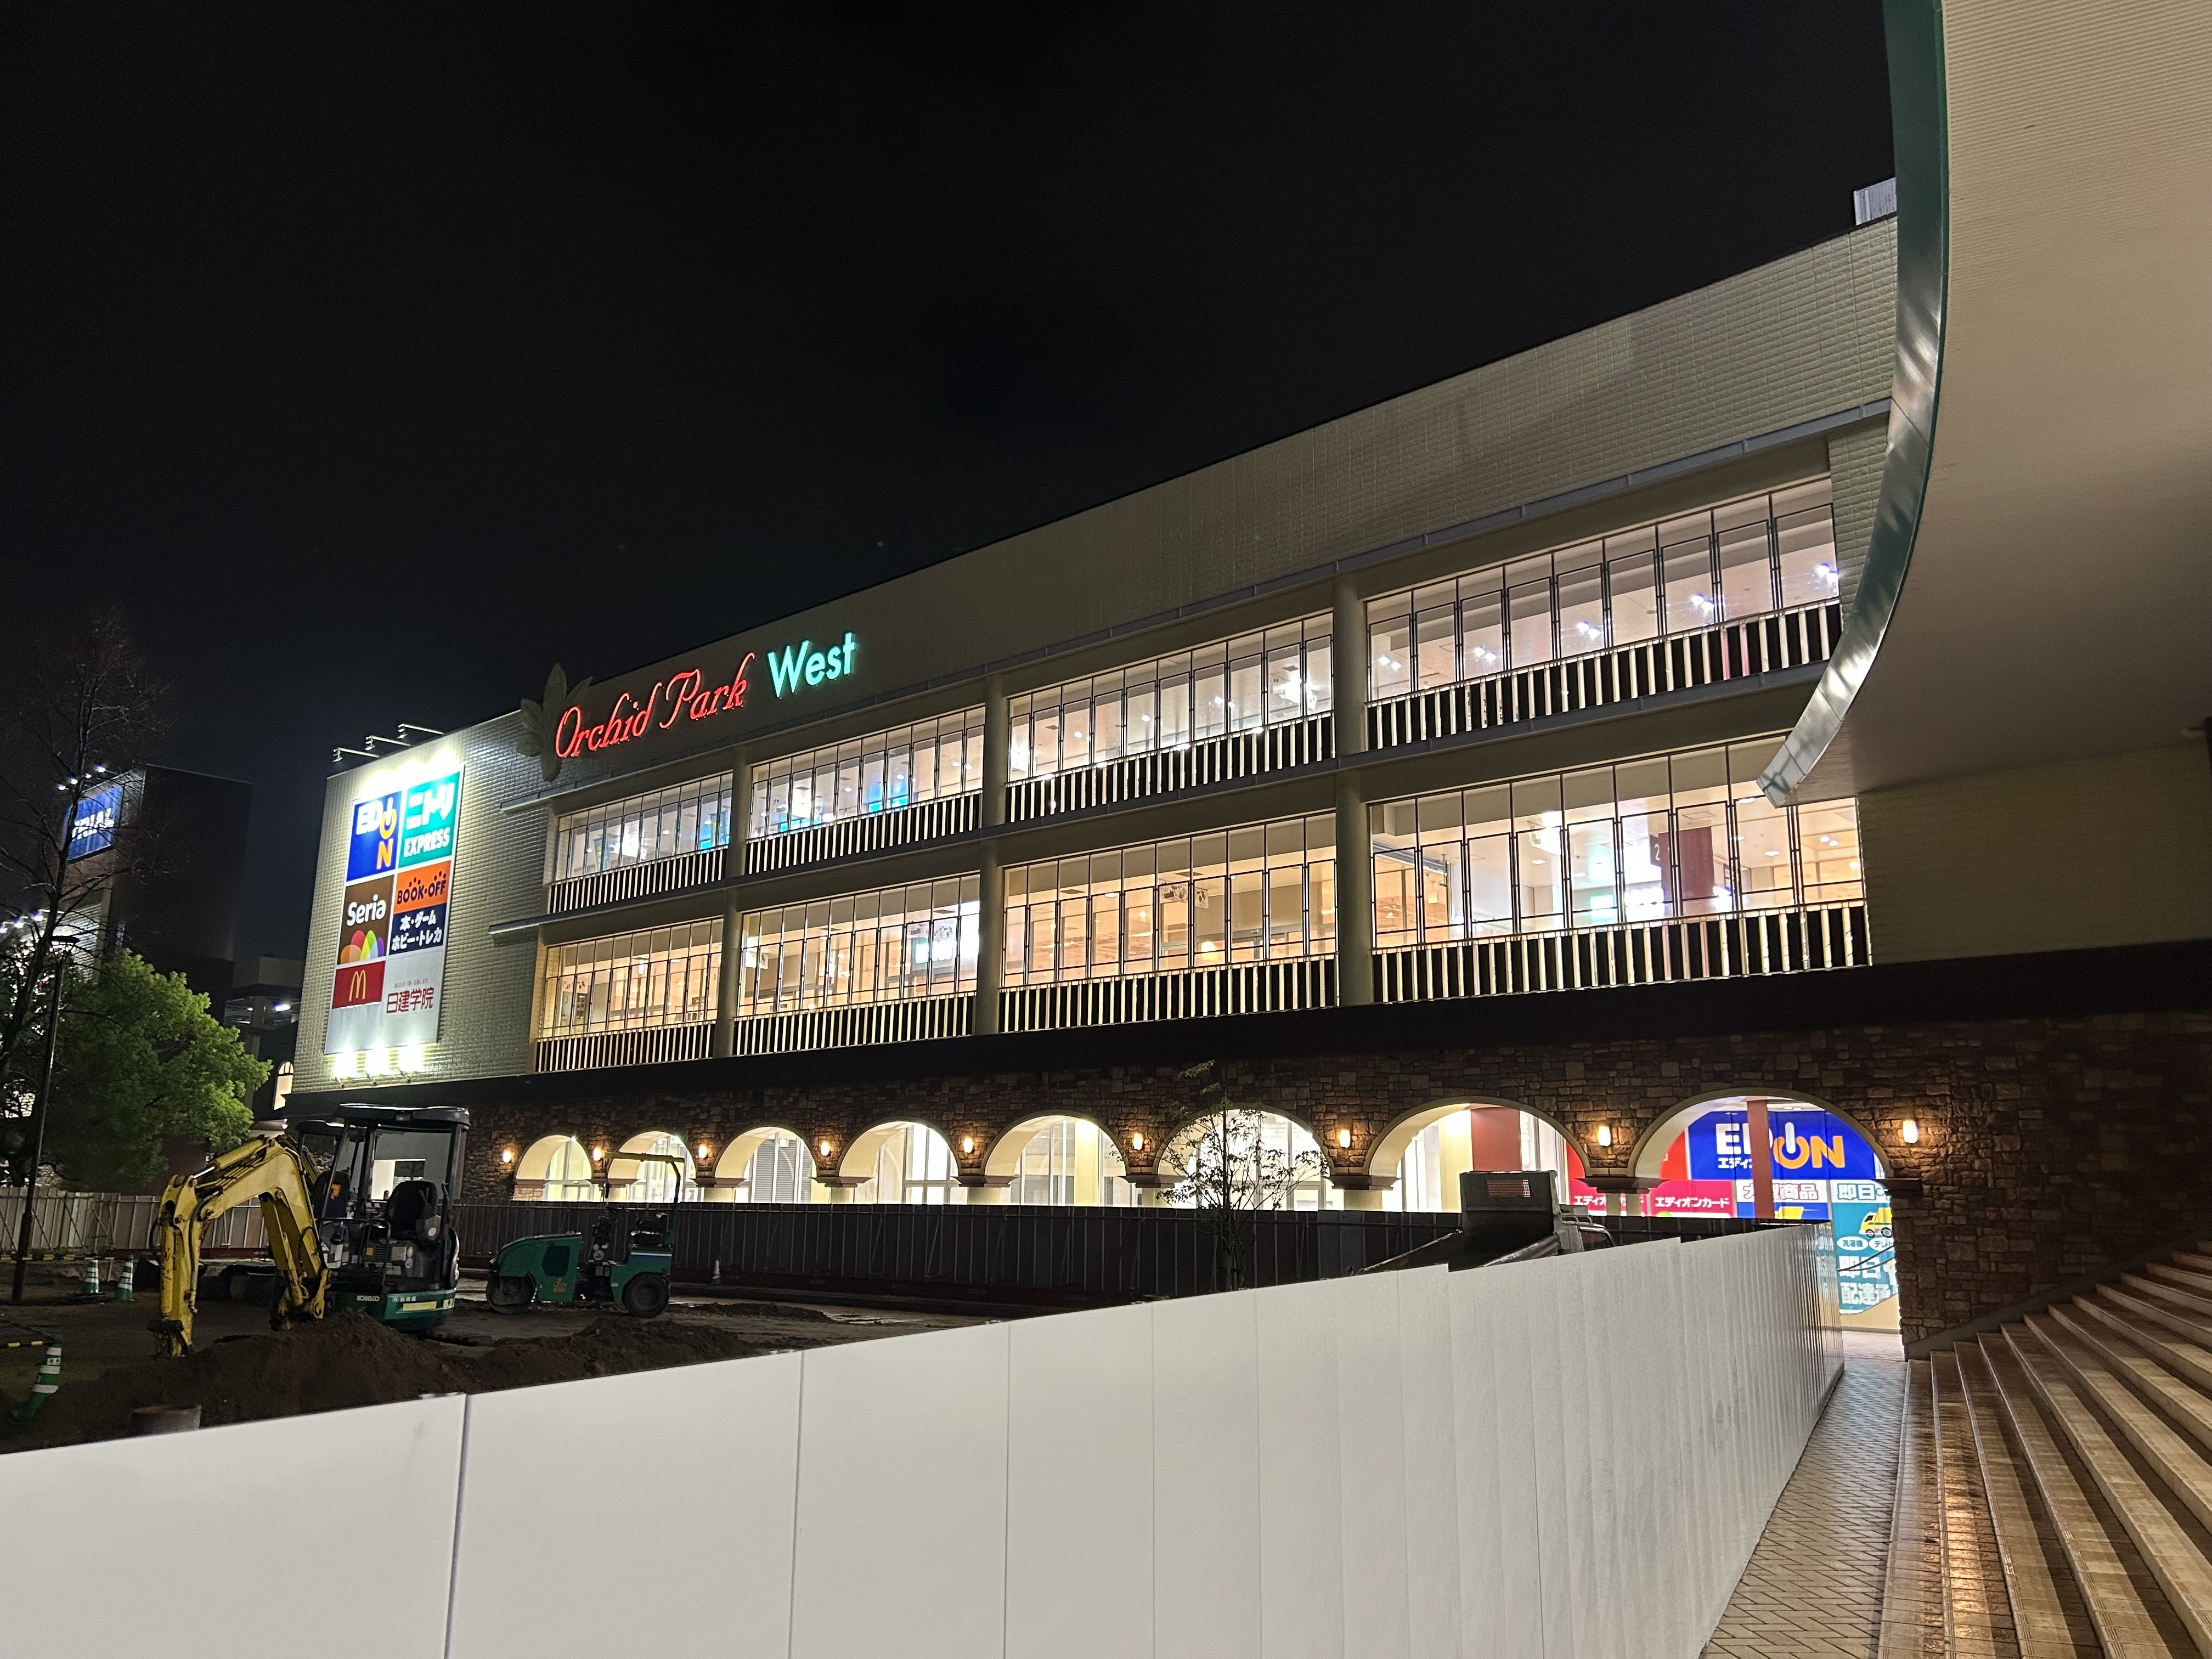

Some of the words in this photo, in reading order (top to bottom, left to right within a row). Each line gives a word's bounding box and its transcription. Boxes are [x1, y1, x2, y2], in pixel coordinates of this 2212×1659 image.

[555, 682, 662, 758] Orchid
[659, 652, 756, 729] Park
[768, 632, 856, 698] West
[405, 782, 455, 830] ニトリ
[403, 827, 450, 857] EXPRESS
[347, 894, 386, 927] Seria
[386, 986, 435, 1014] 日建学院
[1655, 1197, 1730, 1208] エディオンカード
